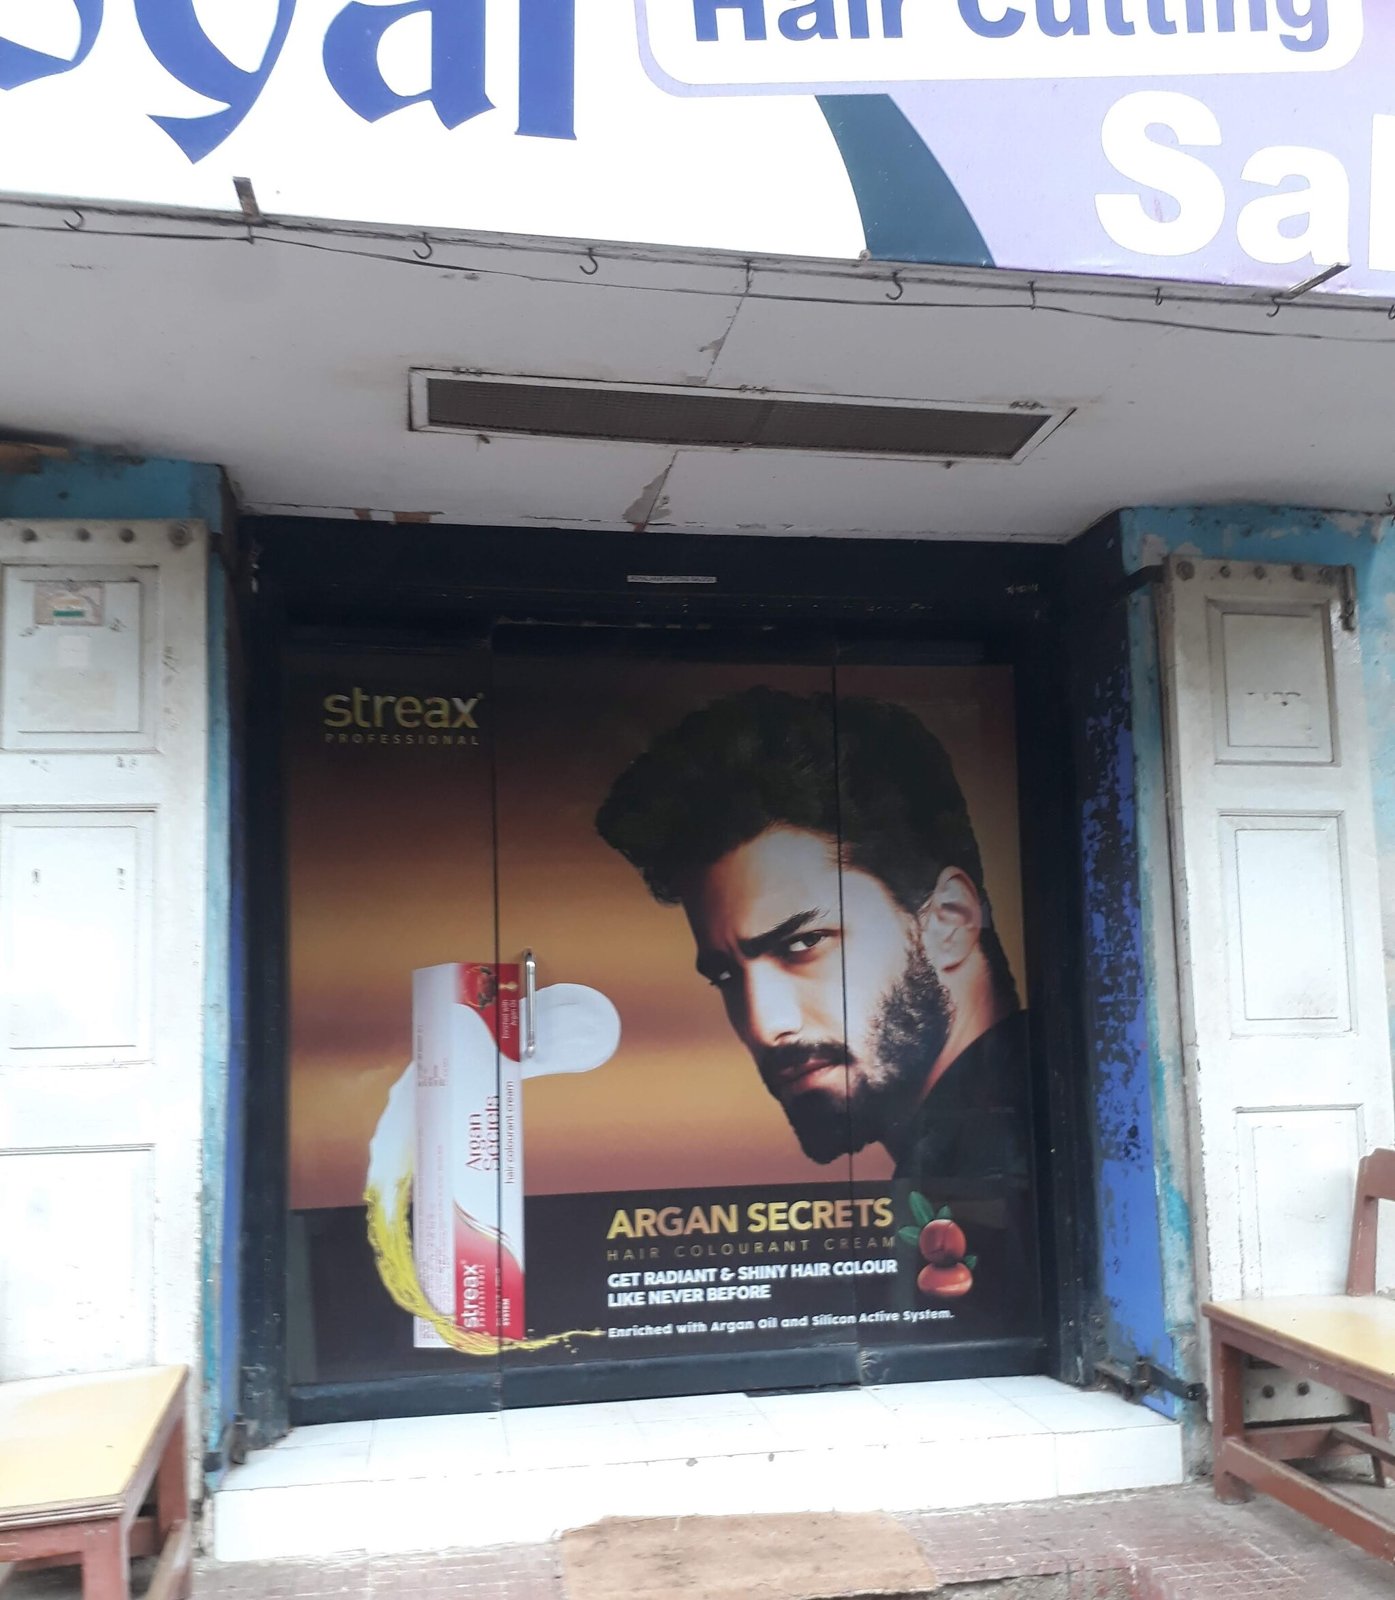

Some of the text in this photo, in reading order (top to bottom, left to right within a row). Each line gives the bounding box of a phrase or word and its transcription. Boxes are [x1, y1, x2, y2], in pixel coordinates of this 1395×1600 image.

[323, 687, 478, 728] streax
[324, 733, 479, 746] PROFESSIONAL
[465, 1113, 487, 1171] Argan
[504, 1081, 515, 1184] hair colourant cream
[606, 1197, 894, 1239] ARGAN SECRETS
[607, 1236, 896, 1261] HAIR COLOURANT CREAM
[607, 1259, 898, 1288] GET RADIANT & SHINY HAIR COLOUR
[461, 1264, 479, 1328] streax
[607, 1284, 772, 1307] LIKE NEVER BEFORE
[608, 1308, 955, 1338] Enriched with Argan Oil and Silicon Active System.
